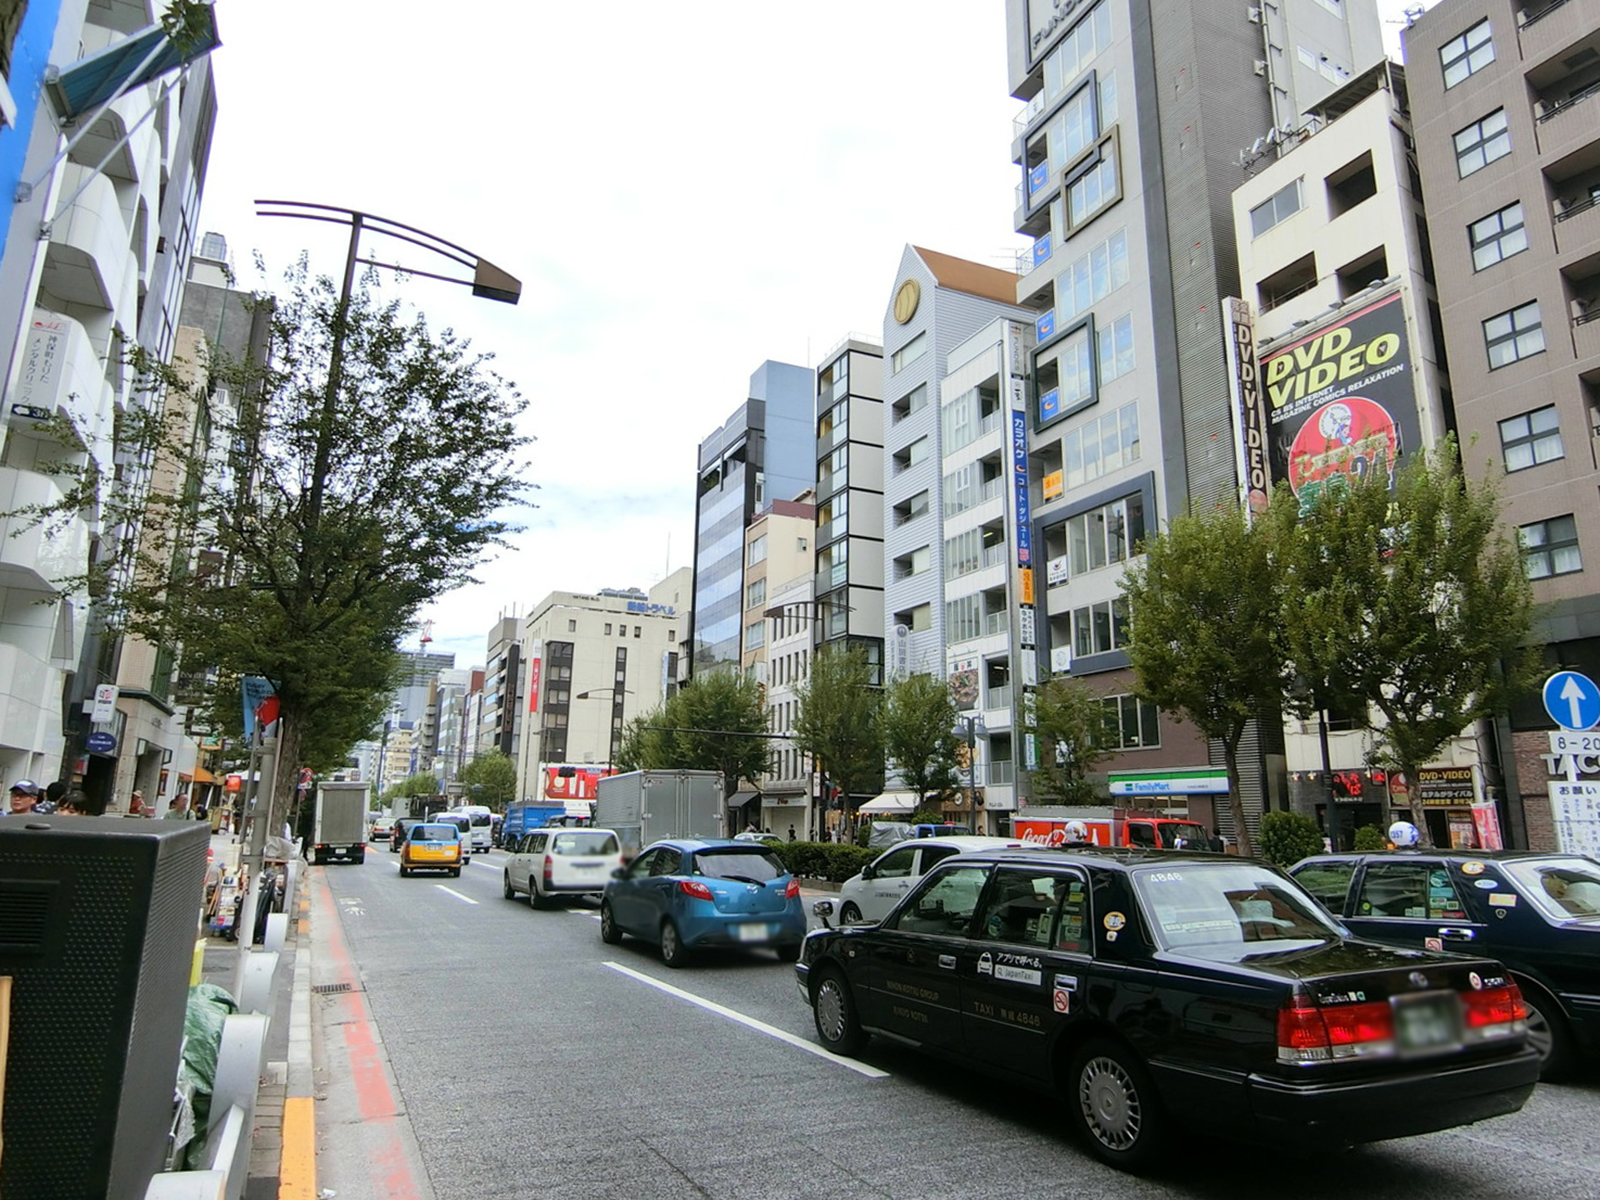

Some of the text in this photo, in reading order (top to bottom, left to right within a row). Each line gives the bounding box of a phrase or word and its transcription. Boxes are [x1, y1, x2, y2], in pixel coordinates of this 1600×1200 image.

[1267, 327, 1352, 386] DVD
[1268, 333, 1400, 409] VIDEO
[1271, 407, 1281, 417] CS
[1295, 385, 1335, 408] INTERNET
[1272, 363, 1404, 425] MAGAZINE COMICS RELAXATION
[1014, 418, 1024, 459] カラオケ
[1135, 782, 1170, 792] FamilyMart
[1559, 786, 1597, 795] お願い
[996, 952, 1042, 969] アプリで呼べる。
[1005, 969, 1034, 981] JapanTaxi
[974, 1001, 994, 1015] TAXI
